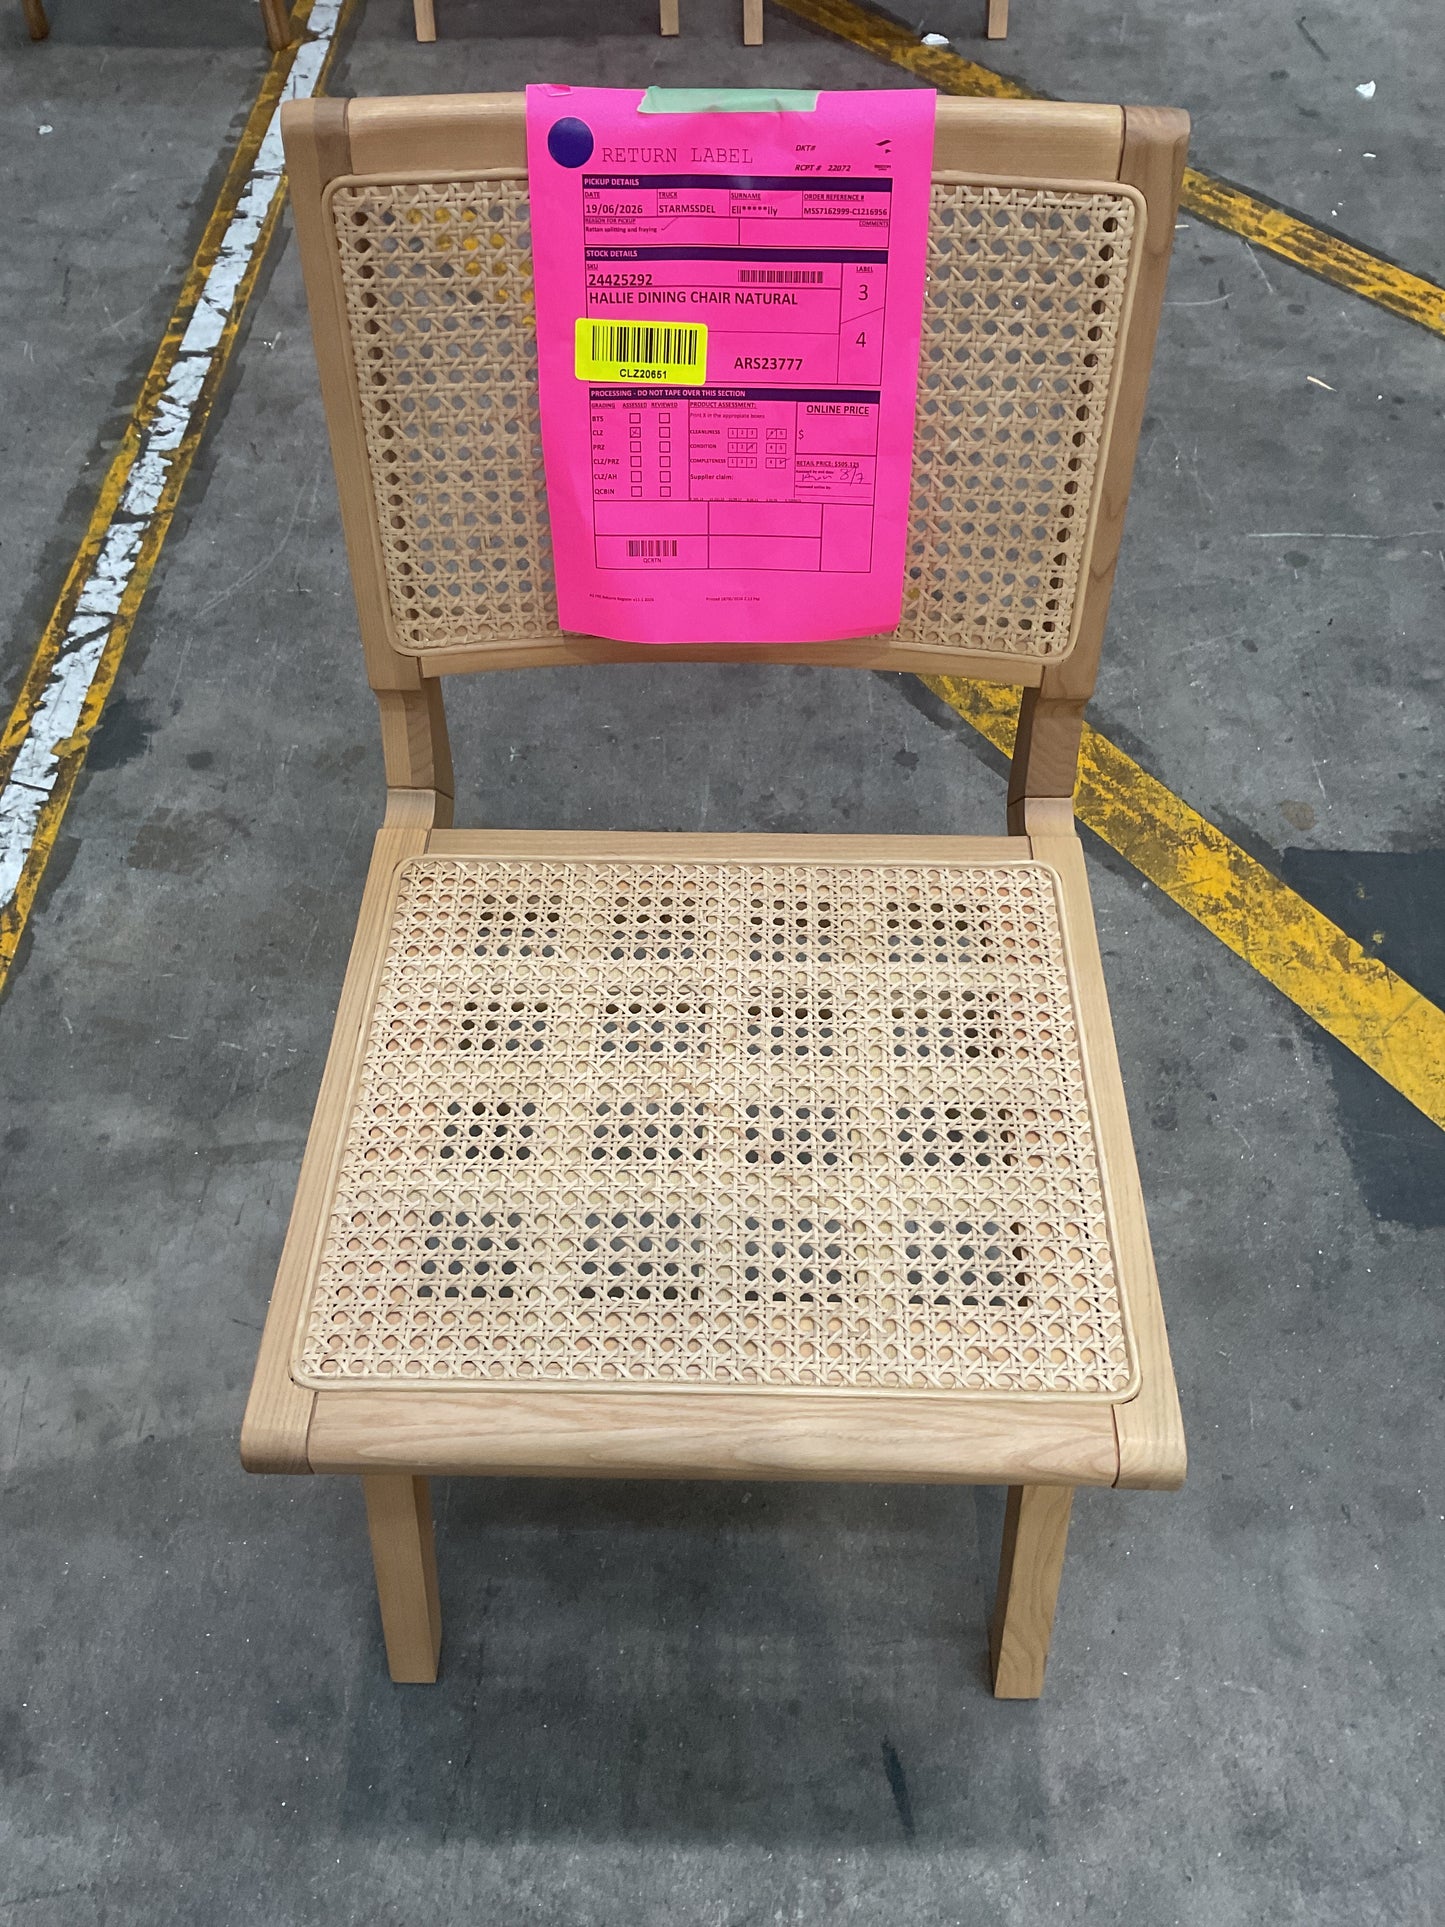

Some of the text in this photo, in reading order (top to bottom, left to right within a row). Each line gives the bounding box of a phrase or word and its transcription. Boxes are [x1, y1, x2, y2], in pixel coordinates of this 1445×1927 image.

[602, 148, 753, 164] RETURN LABEL
[795, 164, 814, 172] RCPT
[584, 178, 640, 186] PICKUP DETAILS
[731, 192, 761, 200] SURNAME
[586, 204, 643, 214] 19/06/2026
[588, 274, 653, 286] 24425292
[858, 284, 868, 300] 3
[589, 292, 798, 305] HALLIE DINING CHAIR NATURAL
[856, 332, 866, 348] 4
[734, 357, 803, 370] ARS23777
[620, 368, 668, 379] CLZ20651
[806, 405, 870, 415] ONLINE PRICE
[798, 429, 804, 440] $
[593, 458, 620, 466] CLZ/PRZ
